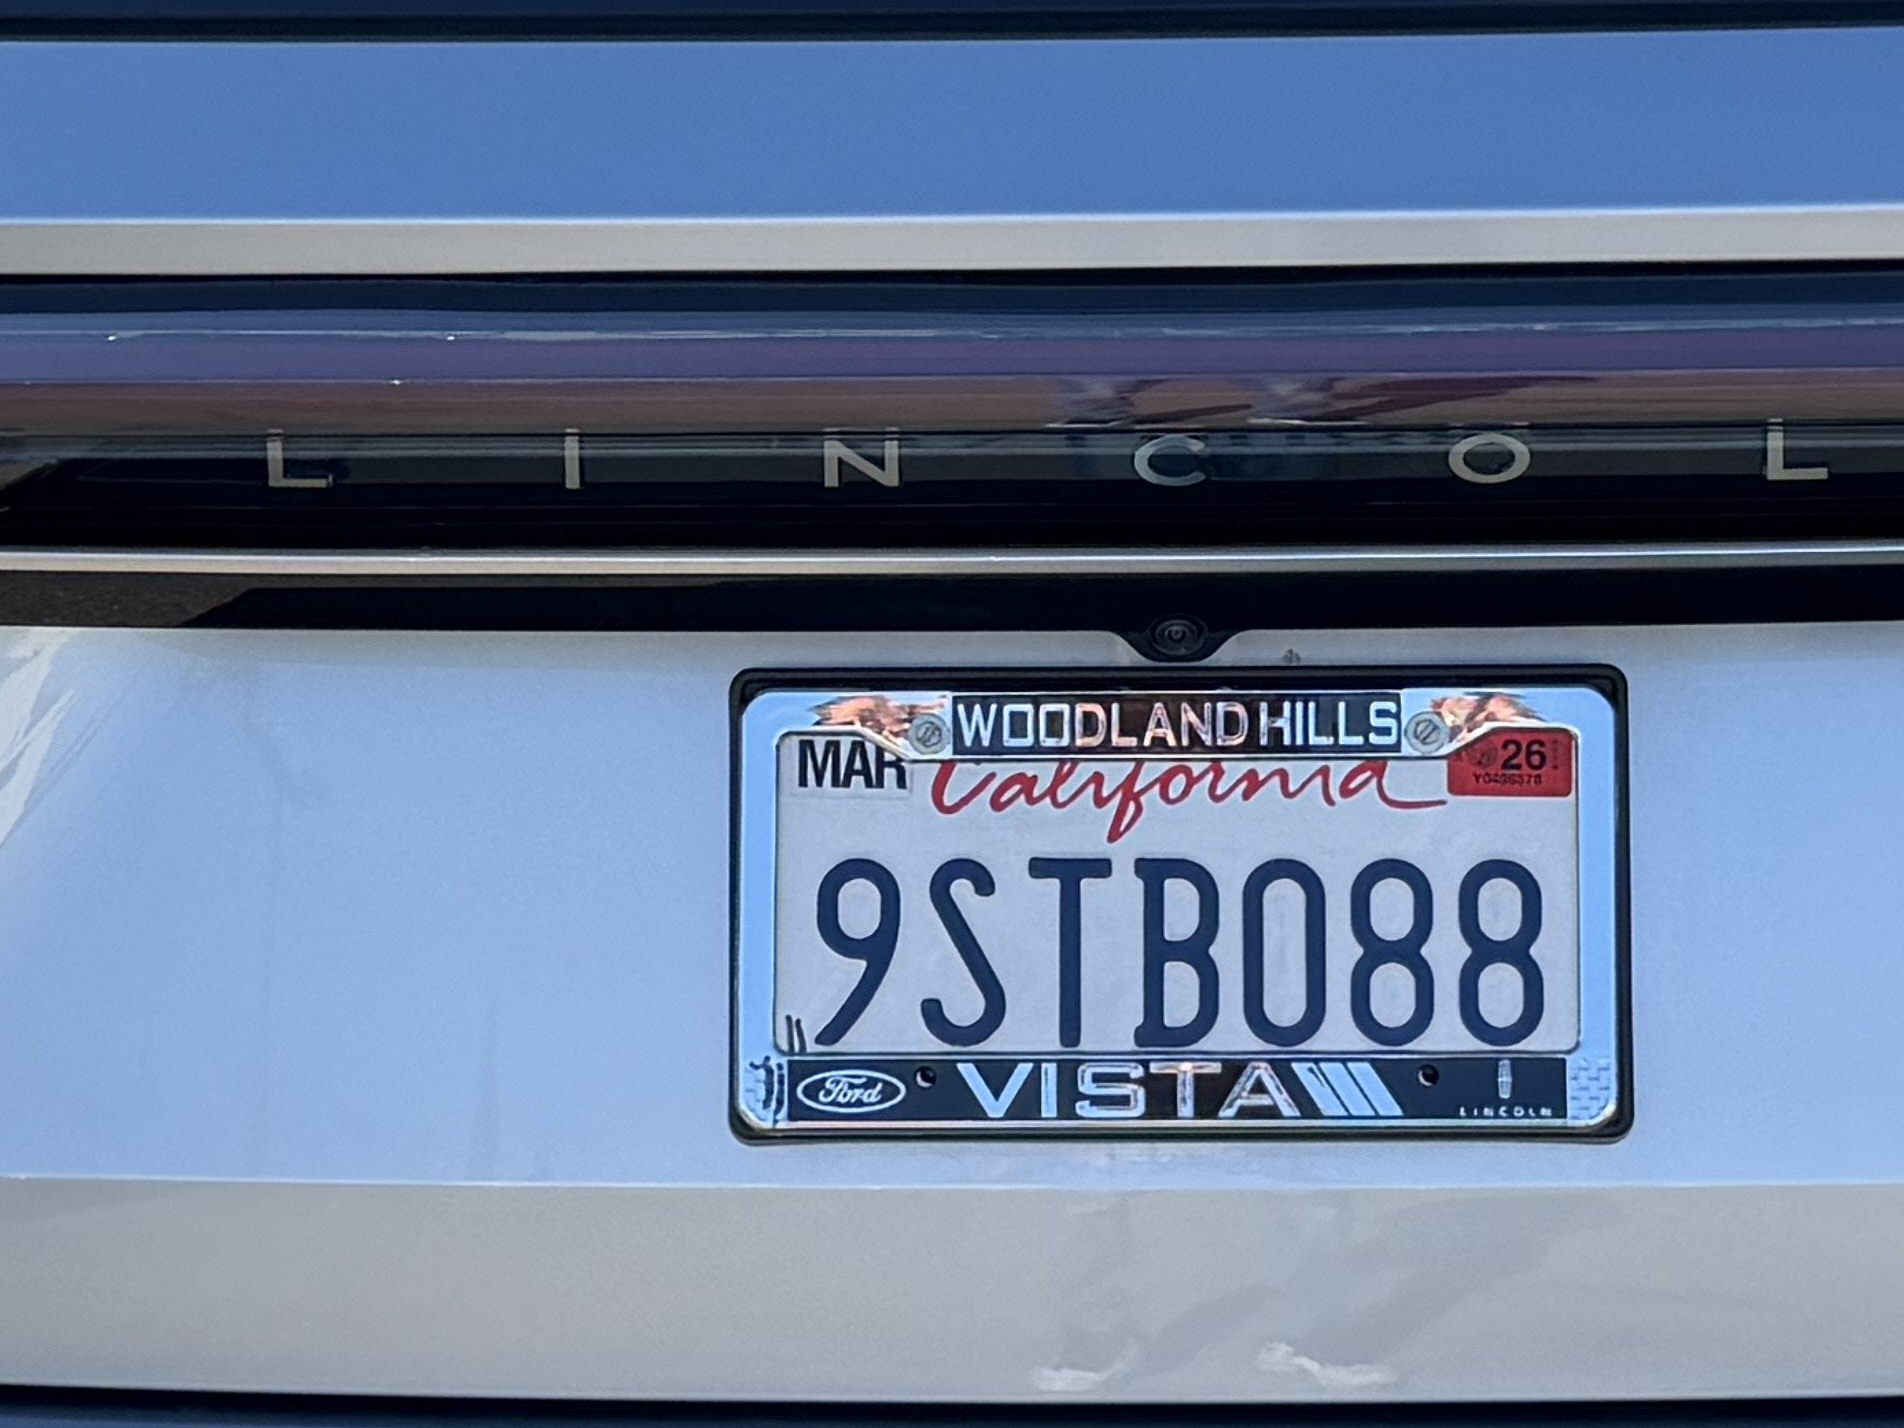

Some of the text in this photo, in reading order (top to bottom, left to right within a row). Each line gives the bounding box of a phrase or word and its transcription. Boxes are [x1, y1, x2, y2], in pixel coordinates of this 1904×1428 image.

[956, 700, 1398, 748] WOODLAND HILLS
[797, 739, 908, 790] MAR
[1500, 738, 1548, 771] 26
[930, 760, 1448, 844] California
[813, 857, 1545, 1048] 9STB088
[956, 1062, 1300, 1118] VISTA
[1459, 1105, 1553, 1117] LINCOLN
